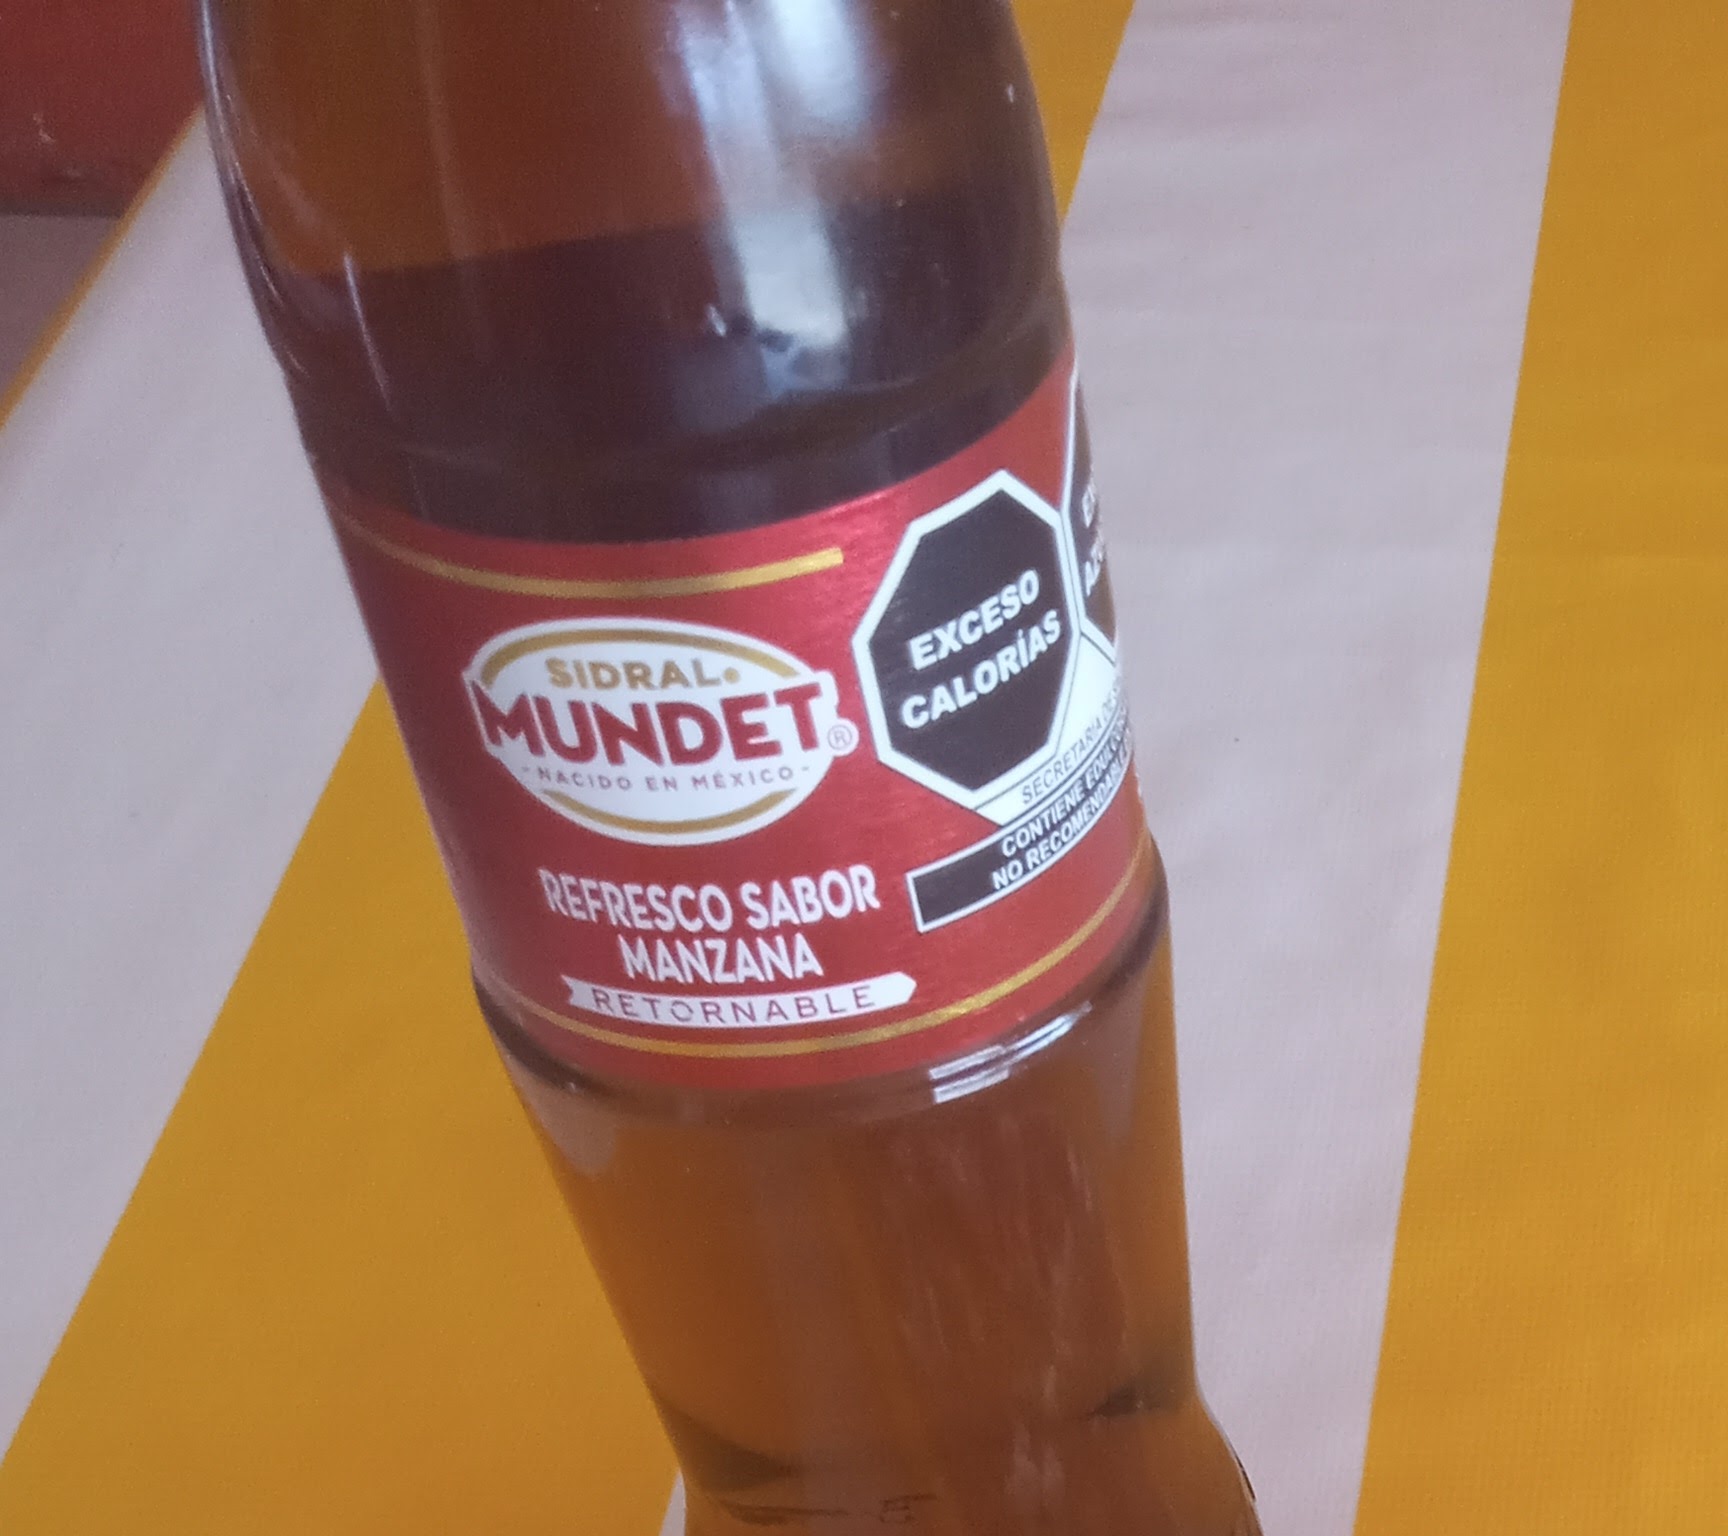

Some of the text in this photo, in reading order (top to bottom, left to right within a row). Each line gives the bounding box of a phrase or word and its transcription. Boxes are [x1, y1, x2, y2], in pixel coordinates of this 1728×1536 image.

[909, 569, 1040, 671] EXCESO
[545, 657, 721, 690] SIDRAL
[902, 609, 1062, 729] CALORÍAS
[471, 682, 823, 766] MUNDET
[537, 765, 794, 791] NACIDO EN MÉXICO
[1002, 778, 1086, 858] CONTIENE
[537, 863, 881, 933] REFRESCO SABOR
[991, 860, 1024, 891] NO
[617, 932, 825, 985] MANZANA
[591, 985, 876, 1024] RETORNABLE
